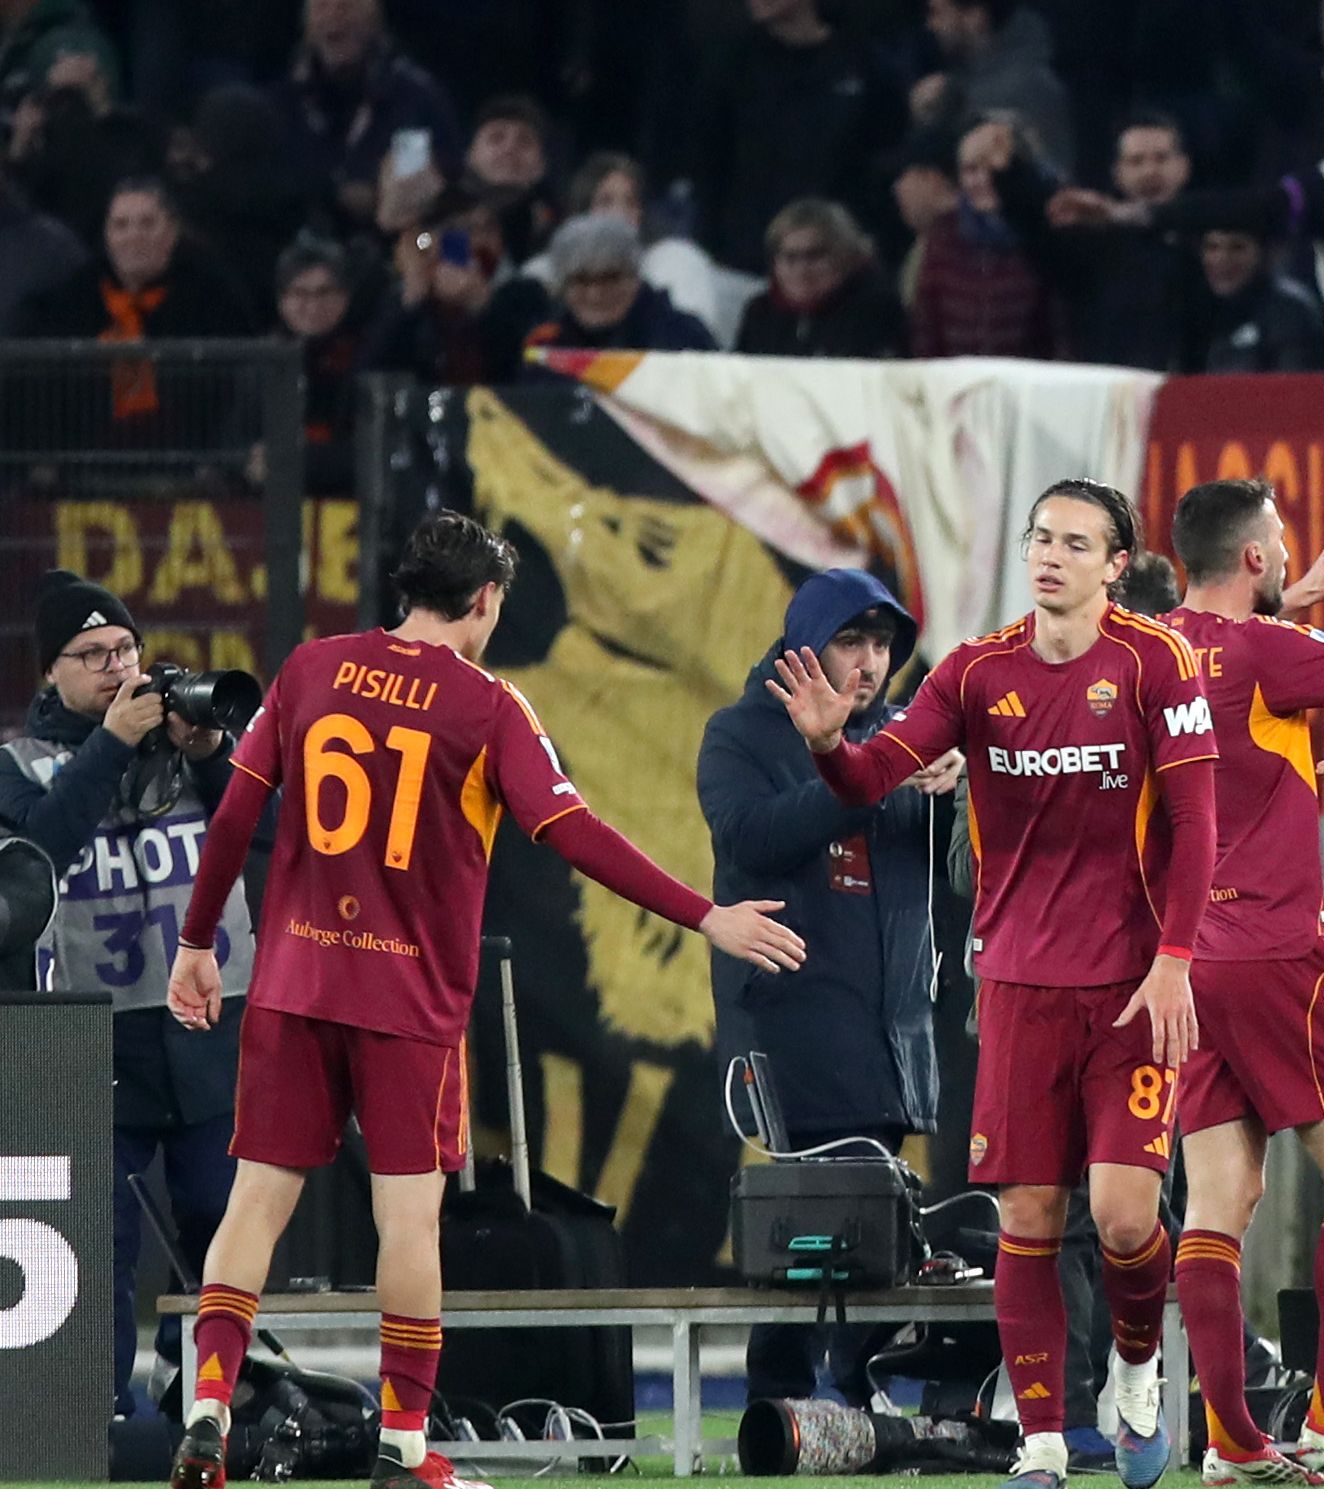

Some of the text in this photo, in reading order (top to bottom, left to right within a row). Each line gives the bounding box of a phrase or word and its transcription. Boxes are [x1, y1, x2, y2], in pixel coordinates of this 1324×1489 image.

[333, 662, 438, 711] PISILLI
[988, 743, 1126, 777] EUROBET
[304, 713, 431, 871] 61
[342, 930, 420, 957] Collection
[1015, 1352, 1049, 1366] ASR
